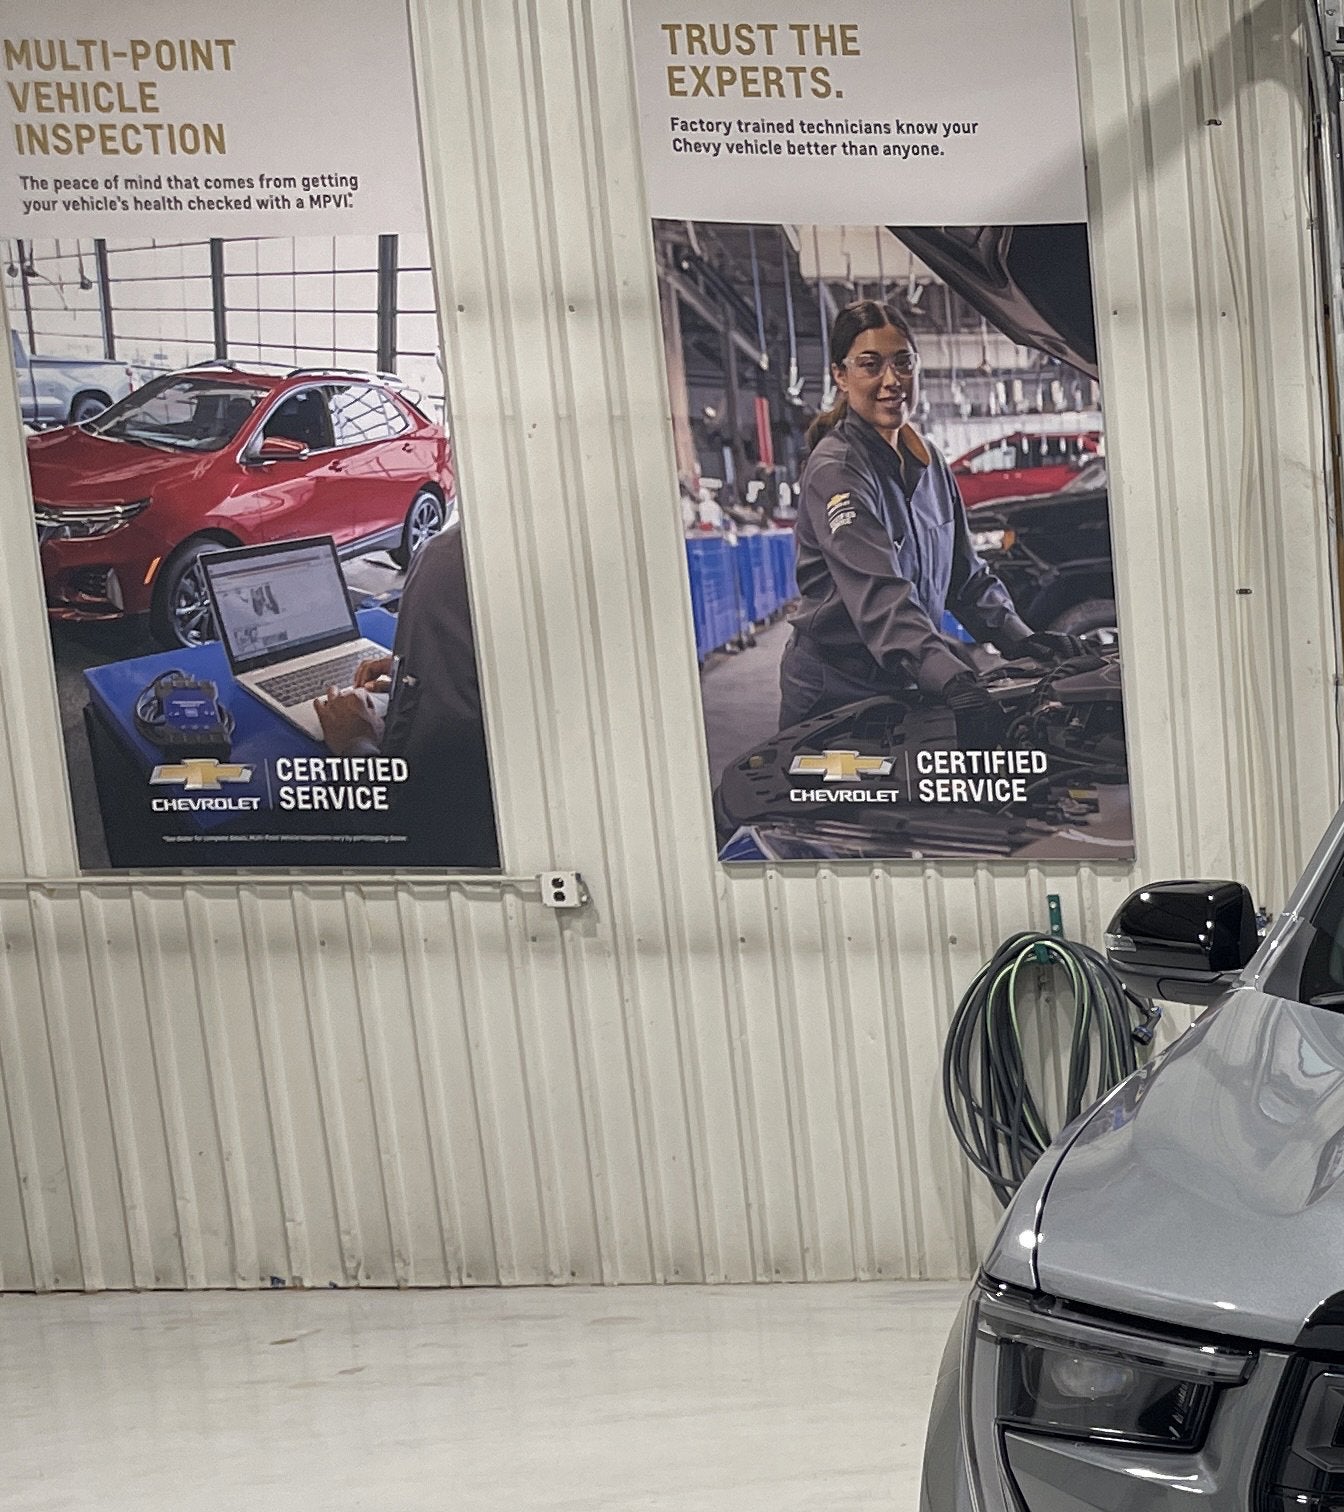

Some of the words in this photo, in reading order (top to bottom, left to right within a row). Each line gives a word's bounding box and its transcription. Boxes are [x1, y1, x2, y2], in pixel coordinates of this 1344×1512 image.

[662, 23, 777, 55] TRUST
[788, 24, 860, 56] THE
[4, 38, 237, 71] MULTI-POINT
[667, 66, 844, 98] EXPERTS.
[8, 81, 159, 113] VEHICLE
[14, 123, 227, 155] INSPECTION
[670, 117, 732, 136] Factory
[737, 118, 795, 134] trained
[799, 119, 891, 134] technicians
[896, 120, 938, 134] know
[942, 122, 978, 137] your
[673, 138, 721, 157] Chevy
[726, 140, 782, 155] vehicle
[787, 140, 838, 156] better
[841, 141, 878, 156] than
[883, 144, 945, 159] anyone.
[20, 175, 48, 191] The
[53, 178, 99, 194] peace
[104, 175, 120, 190] of
[124, 175, 162, 190] mind
[167, 175, 200, 190] that
[204, 177, 254, 190] comes
[259, 174, 297, 189] from
[301, 173, 359, 191] getting
[23, 198, 59, 214] your
[62, 196, 129, 212] vehicle's
[134, 195, 183, 211] health
[188, 195, 252, 210] checked
[256, 195, 291, 209] with
[295, 198, 305, 209] a
[276, 757, 409, 782] CERTIFIED
[917, 750, 1048, 774] CERTIFIED
[279, 786, 389, 810] SERVICE
[790, 789, 900, 802] CHEVROLET
[919, 779, 1028, 802] SERVICE
[151, 797, 261, 812] CHEVROLET
